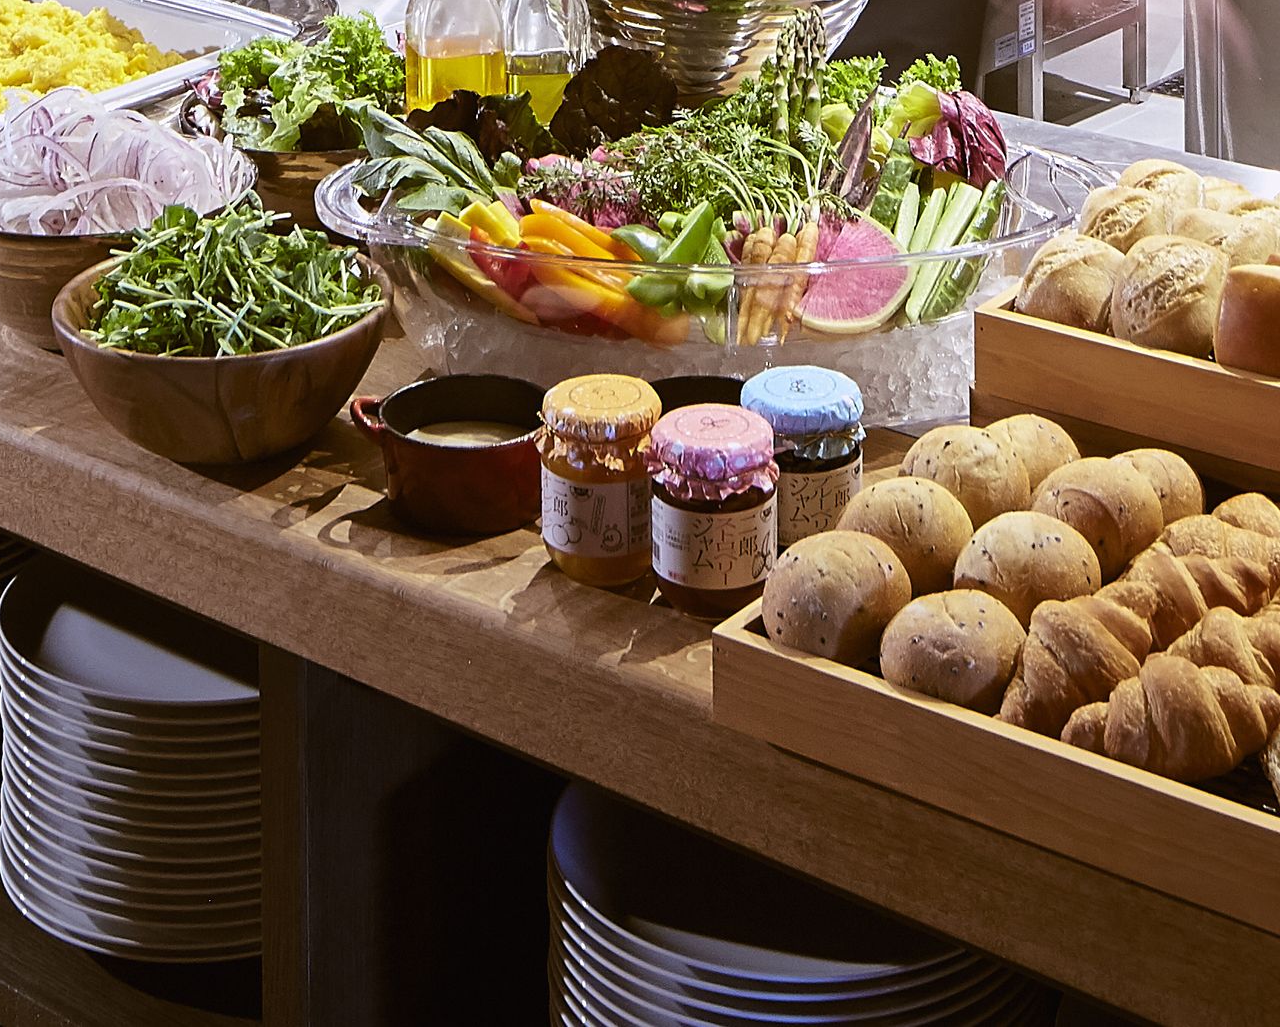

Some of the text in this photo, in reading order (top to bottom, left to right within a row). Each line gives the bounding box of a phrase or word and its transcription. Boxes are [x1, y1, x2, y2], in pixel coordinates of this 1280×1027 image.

[789, 476, 810, 523] ジャム
[691, 516, 714, 570] ジャム
[714, 517, 738, 586] ストロベリー
